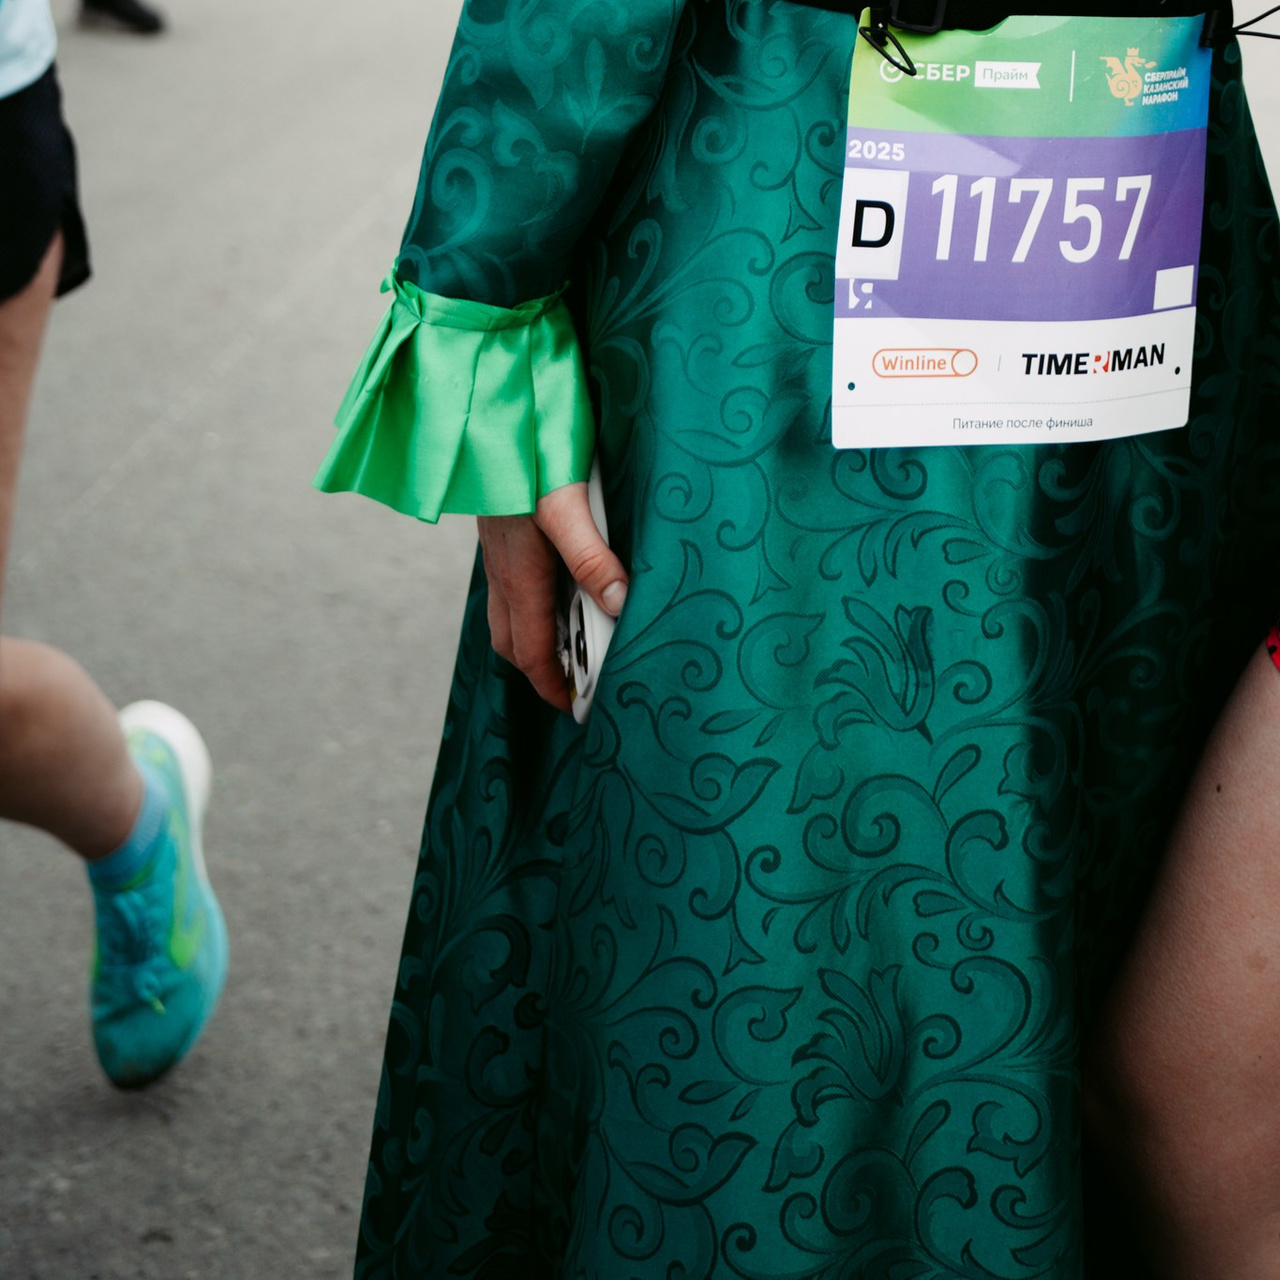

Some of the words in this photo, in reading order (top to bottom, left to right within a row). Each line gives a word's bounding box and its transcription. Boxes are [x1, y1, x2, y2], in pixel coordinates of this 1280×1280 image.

[914, 62, 971, 82] СБЕР
[982, 67, 1029, 83] Прайм
[1144, 66, 1187, 83] СБЕРПРАЙМ
[1143, 76, 1189, 94] КАЗАНСКИЙ
[1141, 91, 1179, 106] МАРАФОН
[848, 139, 906, 162] 2025
[851, 199, 896, 249] D
[931, 174, 1152, 264] 11757
[881, 355, 947, 372] Winline
[952, 416, 1004, 431] Питание
[1006, 418, 1043, 430] после
[1046, 416, 1094, 431] финиша
